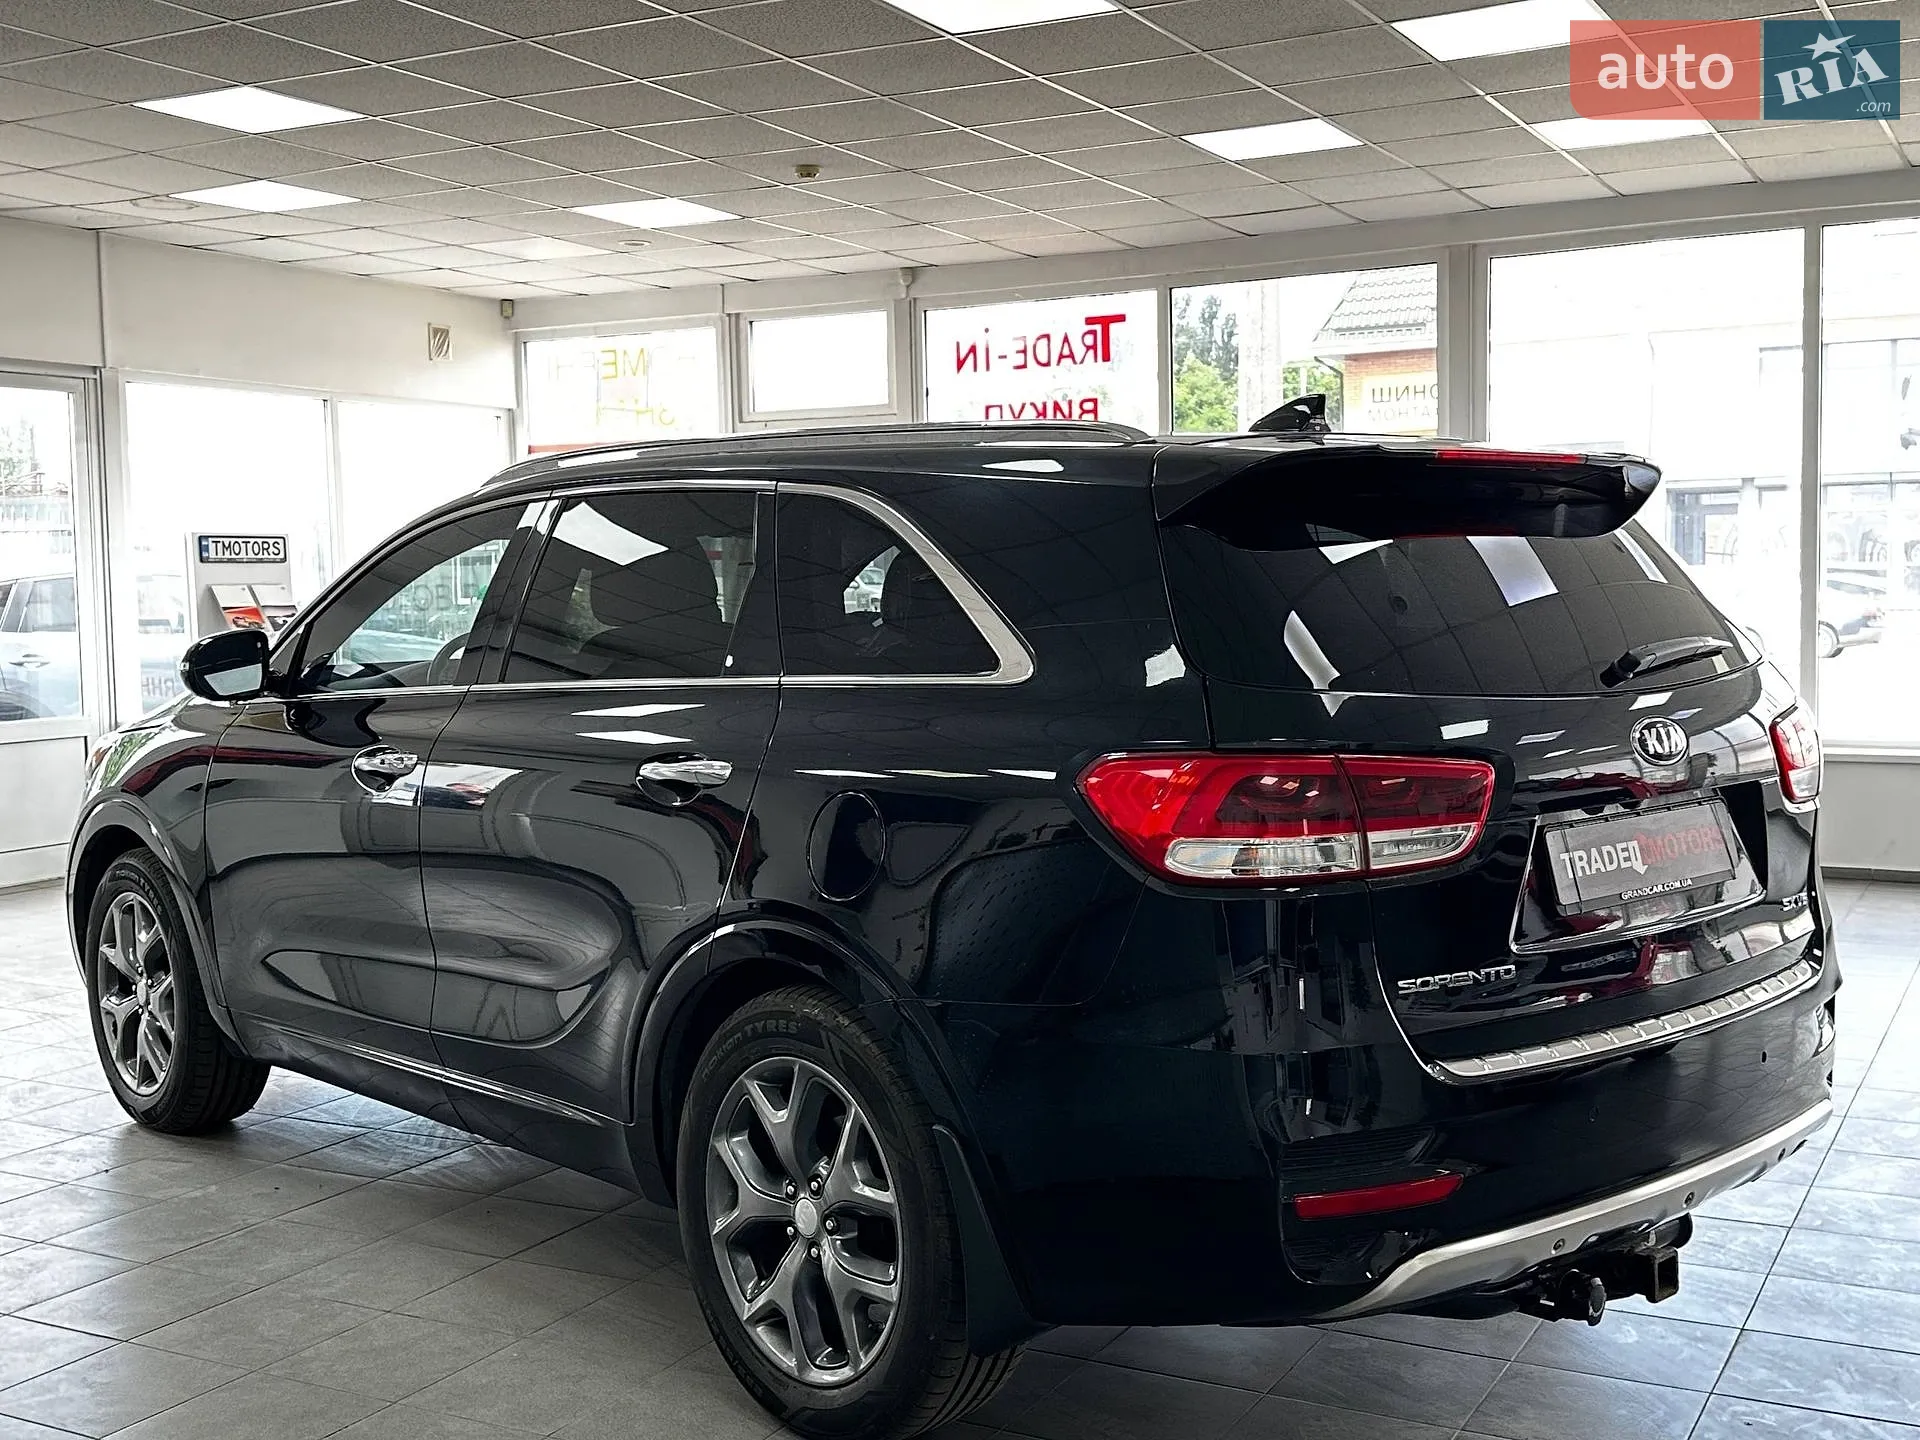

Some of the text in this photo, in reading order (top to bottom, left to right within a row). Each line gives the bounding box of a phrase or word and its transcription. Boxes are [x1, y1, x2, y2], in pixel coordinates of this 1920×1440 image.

[211, 540, 281, 557] TMOTORS
[1641, 725, 1684, 755] KIA
[1621, 878, 1693, 900] GRANDCAR.COM.UA
[1397, 965, 1516, 994] SORENTO
[743, 1018, 800, 1038] TYRES
